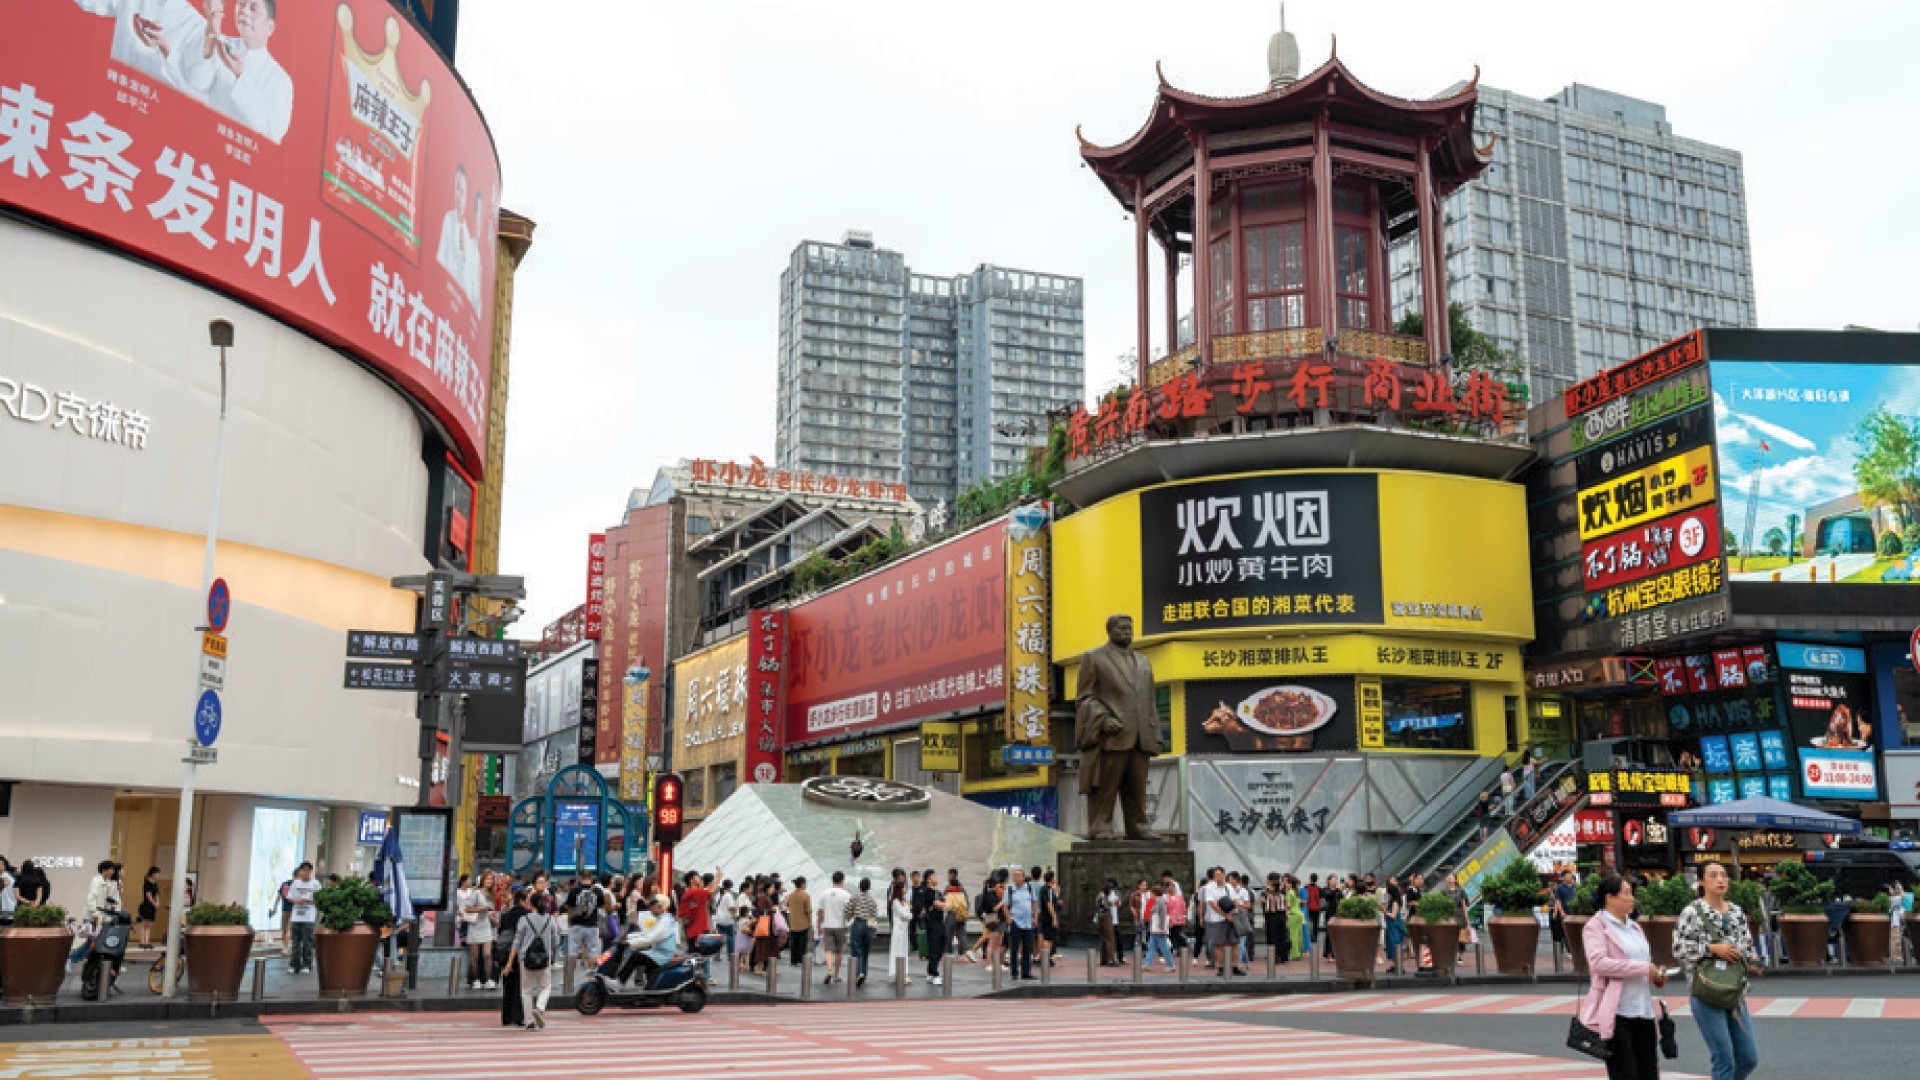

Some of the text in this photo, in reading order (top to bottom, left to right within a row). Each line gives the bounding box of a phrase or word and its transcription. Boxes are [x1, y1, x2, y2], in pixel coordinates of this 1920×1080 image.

[353, 82, 412, 152] 麻辣王子
[1582, 476, 1648, 531] 炊烟
[1177, 490, 1330, 556] 炊烟
[1682, 527, 1701, 548] 3F
[1178, 554, 1333, 586] 小炒黄牛肉
[1162, 594, 1356, 623] 走进联合国的湘菜代表
[363, 634, 419, 651] 解放西路
[450, 640, 504, 656] 解放西路
[1015, 547, 1047, 738] 周六福珠宝
[1202, 646, 1329, 668] 长沙湘菜排队王
[1377, 646, 1504, 670] 长沙湘菜排队王 2F
[1215, 806, 1331, 836] 长沙我来了
